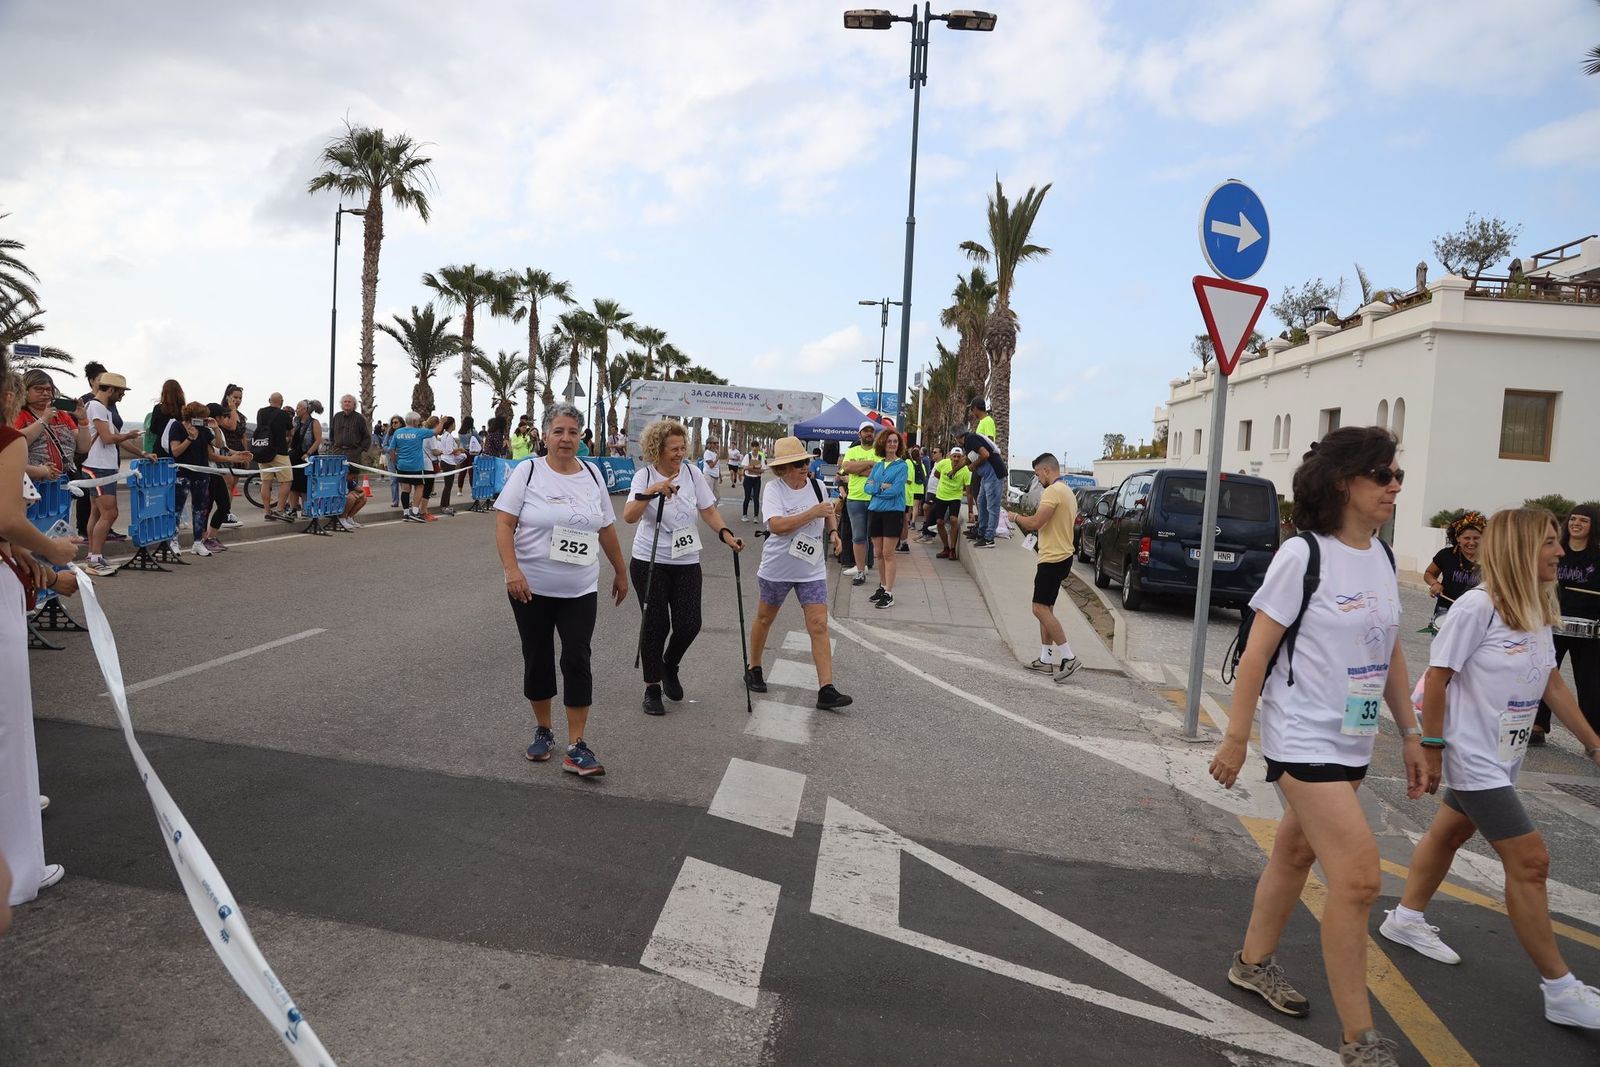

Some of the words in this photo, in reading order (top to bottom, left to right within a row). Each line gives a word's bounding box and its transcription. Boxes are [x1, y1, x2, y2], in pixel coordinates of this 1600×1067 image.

[704, 391, 747, 400] CARRERA
[749, 393, 760, 401] 5K
[251, 437, 269, 447] VANS
[559, 539, 589, 556] 252
[674, 534, 694, 548] 483
[796, 541, 815, 555] 550
[1217, 552, 1232, 561] HNR
[1361, 700, 1378, 720] 33
